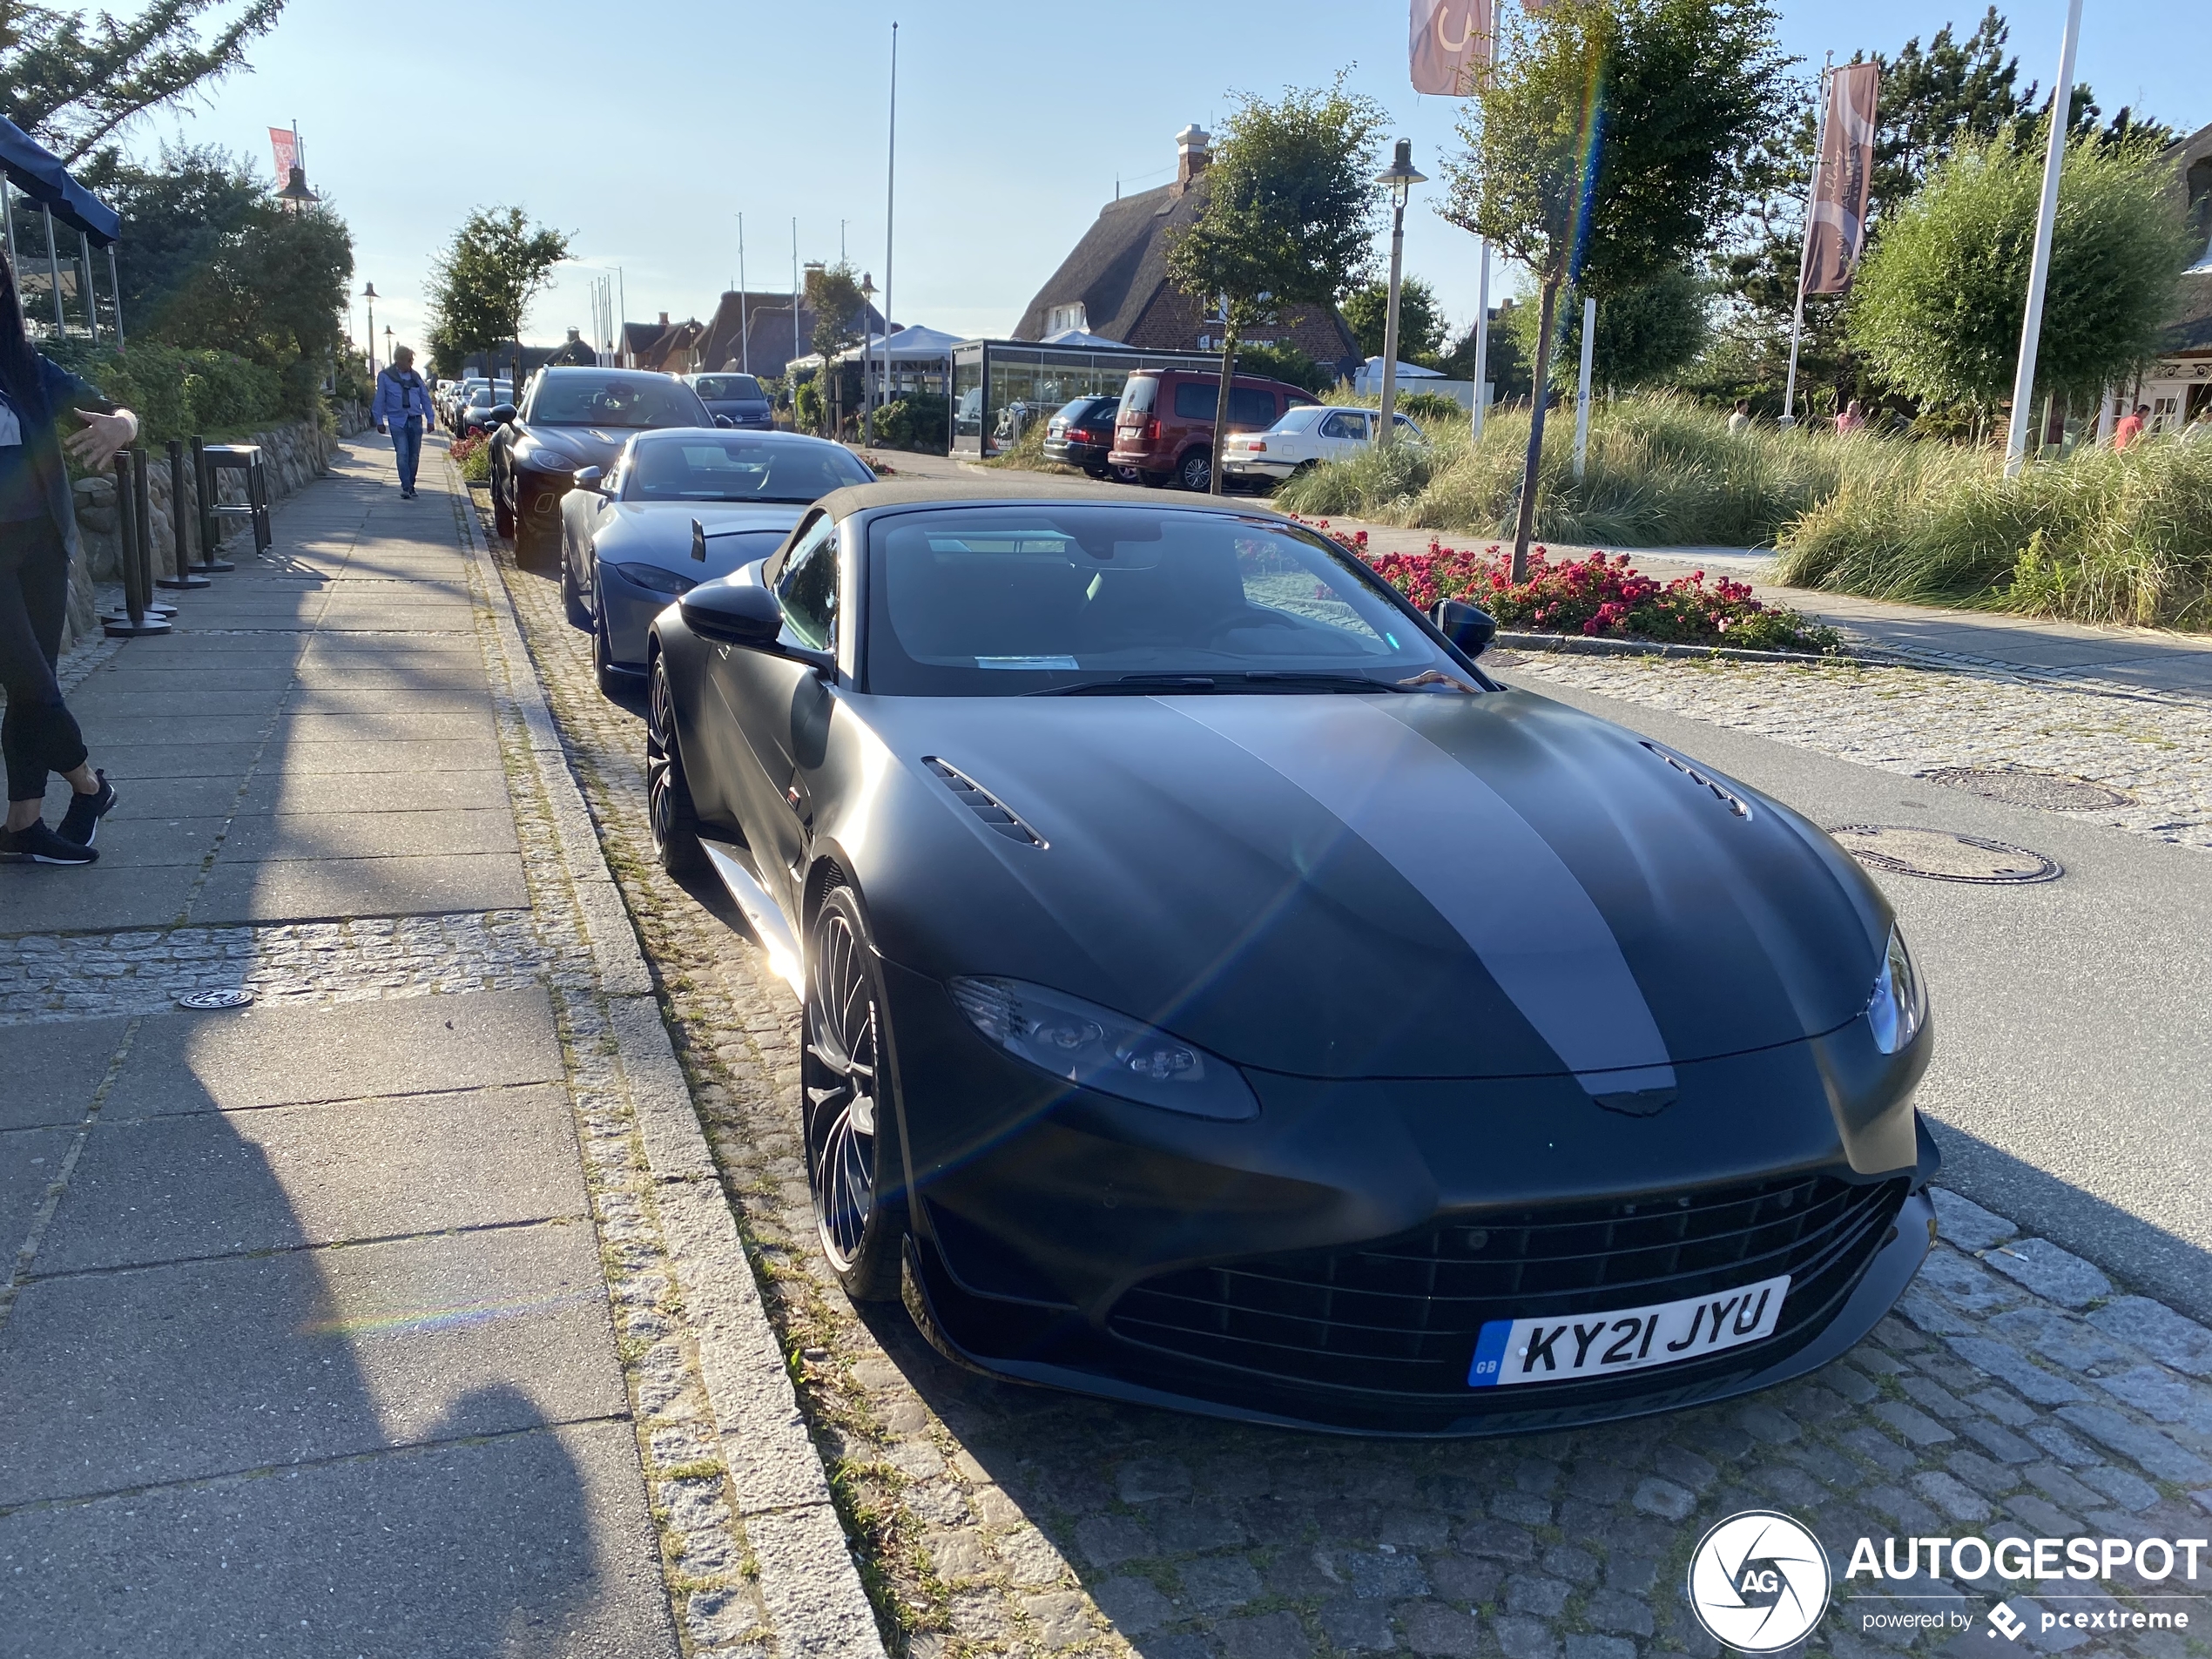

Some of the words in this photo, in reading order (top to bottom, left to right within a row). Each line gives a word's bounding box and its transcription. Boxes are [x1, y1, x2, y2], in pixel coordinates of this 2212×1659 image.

[1824, 144, 1847, 203] allery
[1522, 1314, 1659, 1372] KY21
[1667, 1288, 1770, 1352] JYU
[1476, 1360, 1497, 1373] GB
